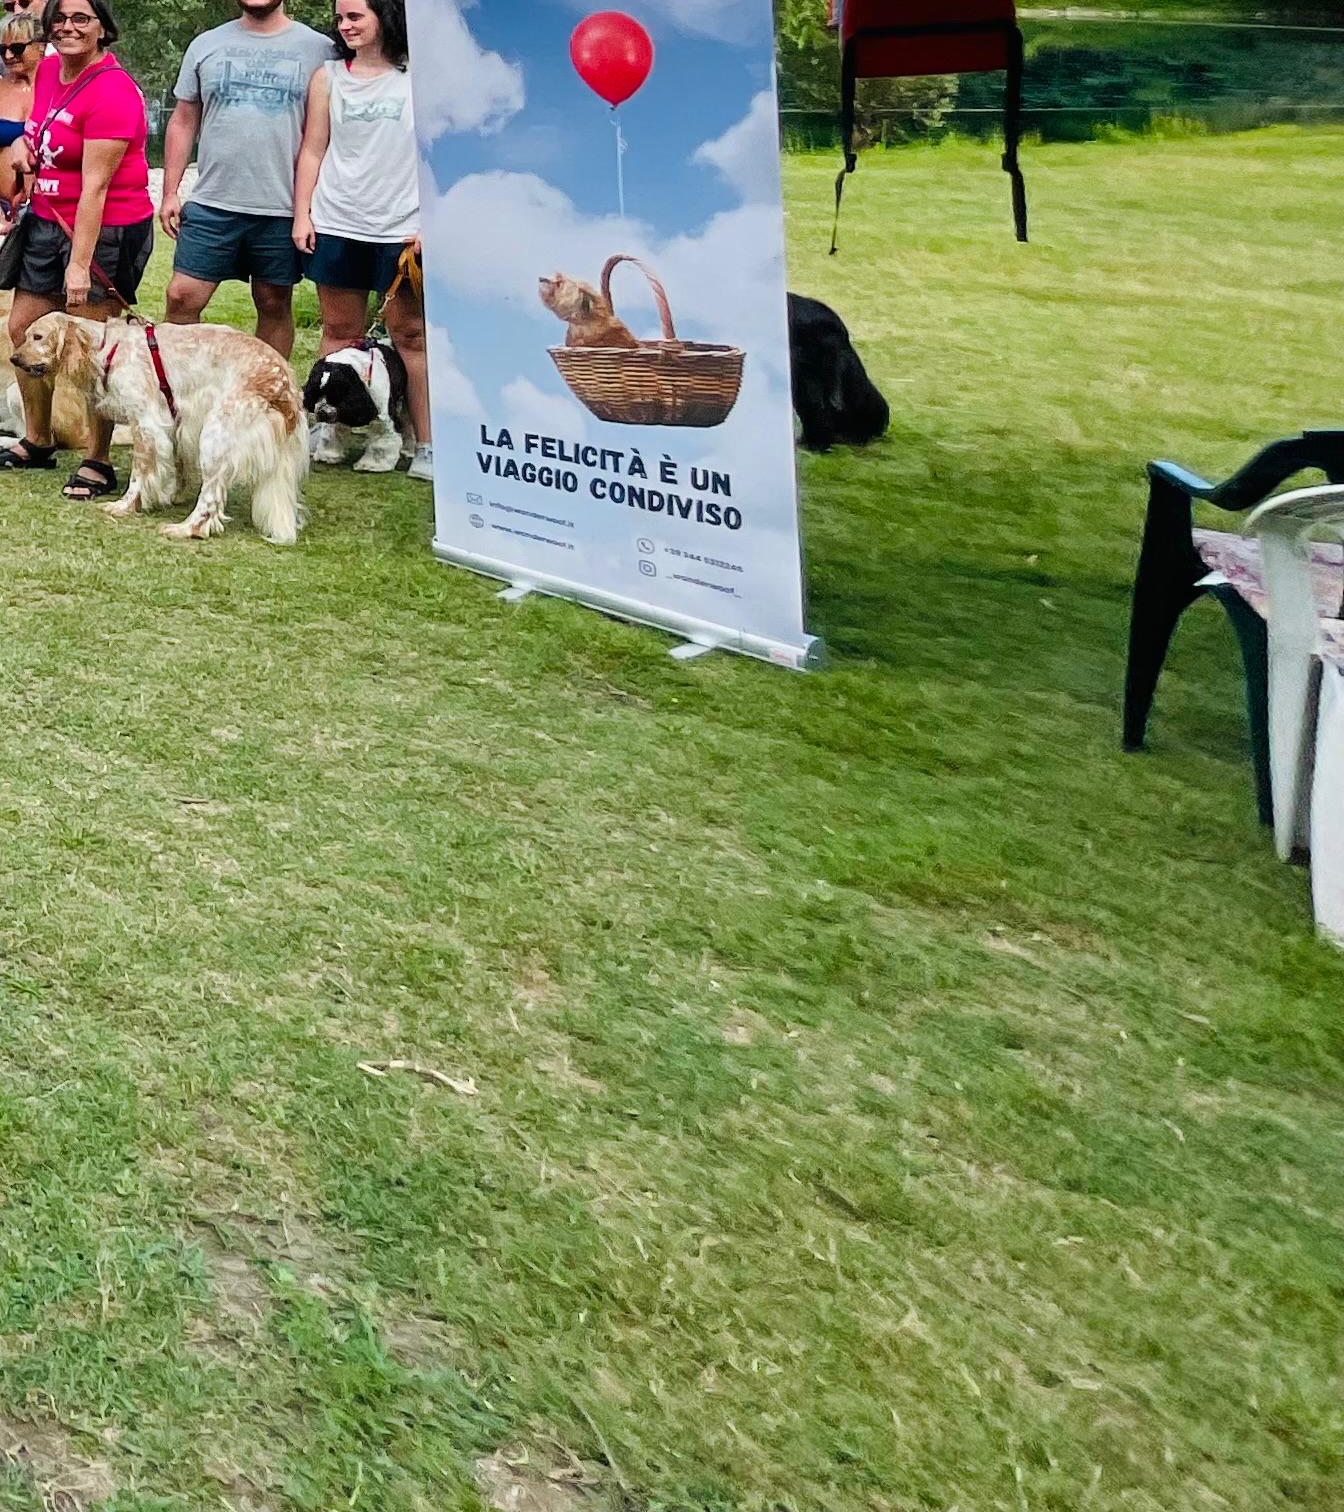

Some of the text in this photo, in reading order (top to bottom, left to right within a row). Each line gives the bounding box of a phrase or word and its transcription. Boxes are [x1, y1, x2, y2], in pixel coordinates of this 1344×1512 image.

[476, 451, 742, 530] VIAGGIO CONDIVISO
[480, 424, 732, 497] LA FELICITÀ È UN
